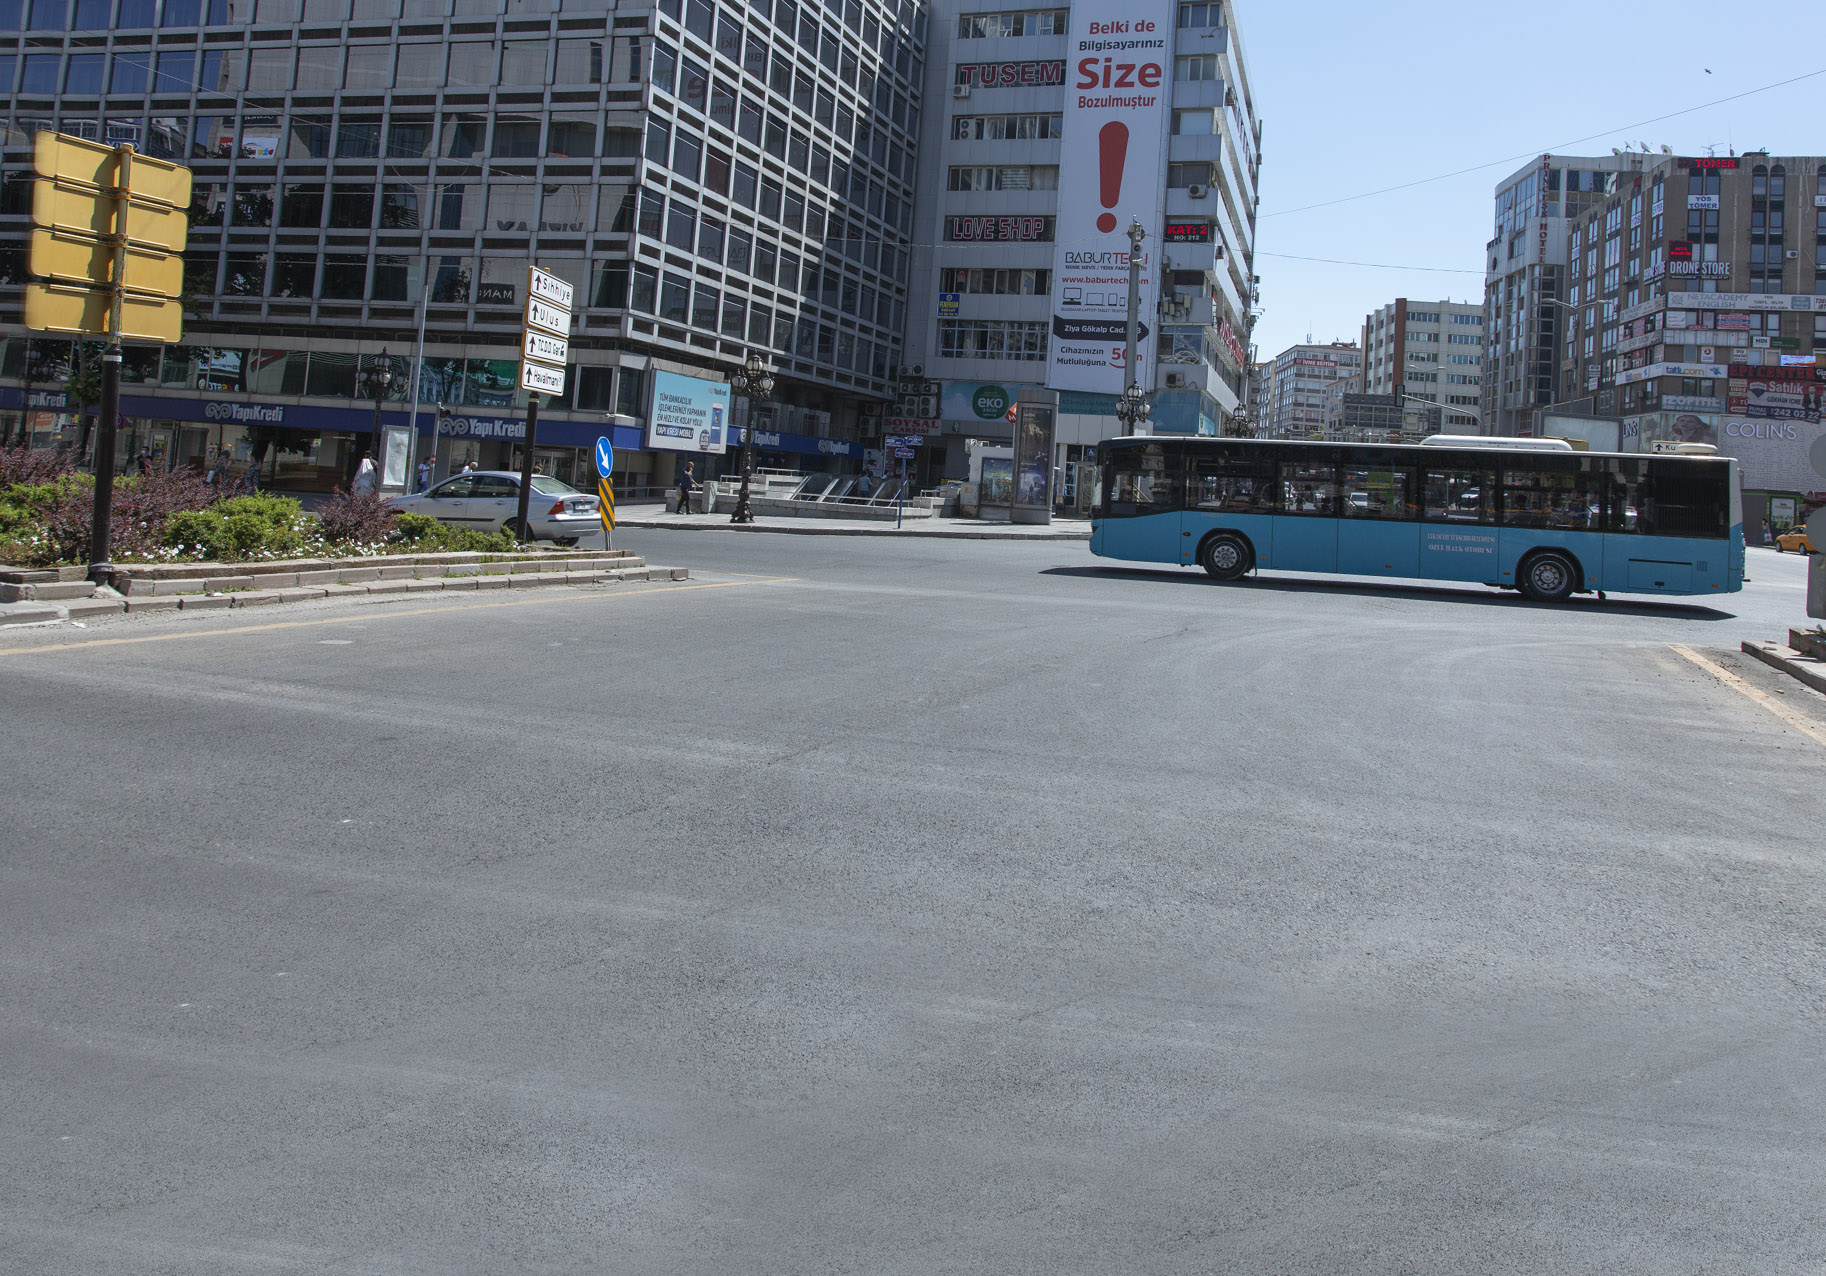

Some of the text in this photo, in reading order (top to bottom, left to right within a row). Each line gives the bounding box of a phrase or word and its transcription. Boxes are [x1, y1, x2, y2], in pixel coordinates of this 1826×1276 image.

[1089, 19, 1155, 35] Belki de
[1079, 39, 1164, 52] Bilgisayarınız
[961, 61, 1062, 86] TUSEM
[1076, 57, 1162, 90] Size
[1078, 94, 1157, 110] Bozulmuştur
[953, 217, 1044, 240] LOVE SHOP
[1168, 225, 1208, 235] KAT: 2
[1669, 261, 1731, 275] DRONE STORE
[1687, 293, 1749, 302] NETACADEMY
[1697, 301, 1736, 309] ENGLISH
[540, 309, 559, 327] Ulus
[1064, 324, 1080, 333] Ziya
[1081, 325, 1108, 334] Gökalp
[1109, 326, 1126, 334] Cad.
[1060, 346, 1104, 355] Cihazınızın
[1057, 358, 1107, 366] Mutluluğuna
[1768, 380, 1804, 395] Satılık
[977, 397, 1003, 409] eko
[1774, 408, 1791, 417] 242
[1793, 410, 1806, 418] 02
[1807, 411, 1821, 420] 22
[883, 417, 939, 429] SOYSAL
[1725, 422, 1798, 440] COLIN'S
